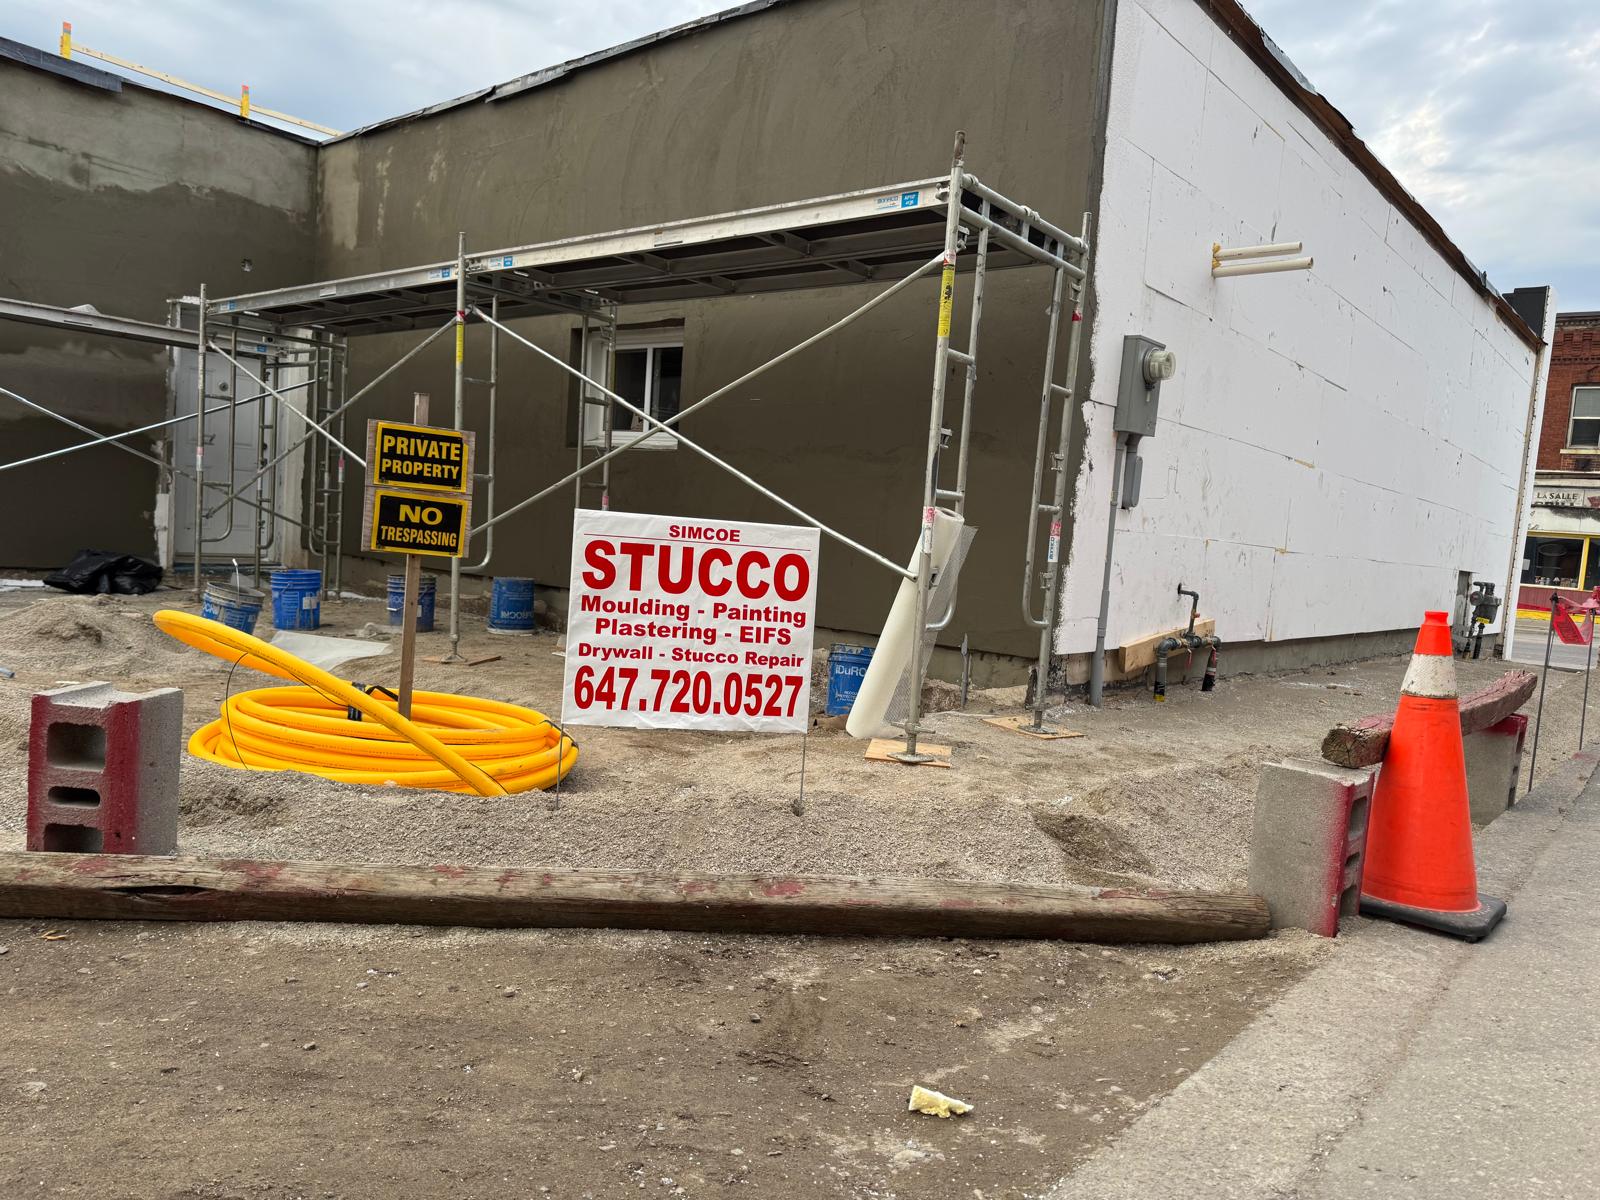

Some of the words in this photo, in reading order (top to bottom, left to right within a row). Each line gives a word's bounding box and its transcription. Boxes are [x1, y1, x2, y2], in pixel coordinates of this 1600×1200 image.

[383, 434, 461, 461] PRIVATE
[381, 458, 460, 480] PROPERTY
[1550, 492, 1578, 500] SALLE
[398, 504, 443, 526] NO
[381, 525, 457, 547] TRESPASSING
[669, 524, 741, 543] SIMCOE
[582, 539, 810, 602] STUCCO
[581, 594, 690, 622] Moulding
[713, 602, 806, 629] Painting
[595, 617, 717, 646] Plastering
[740, 625, 792, 646] EIFS
[578, 642, 653, 662] Drywall
[671, 647, 739, 665] Stucco
[745, 651, 805, 669] Repair
[574, 664, 804, 718] 647.720.0527
